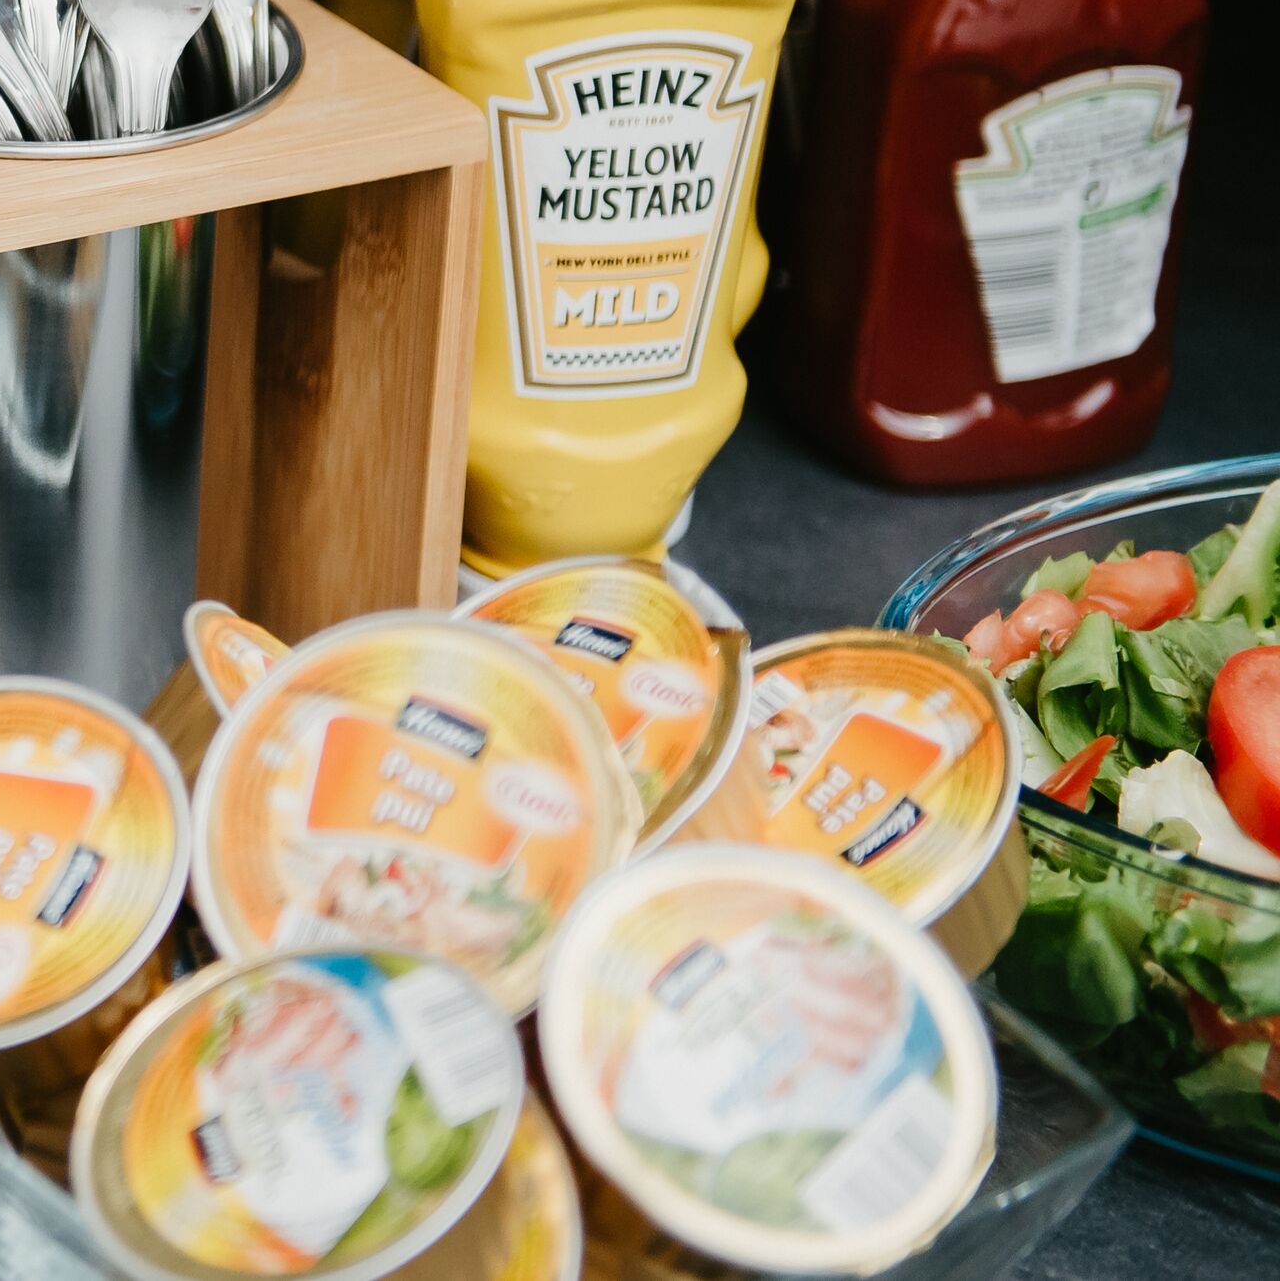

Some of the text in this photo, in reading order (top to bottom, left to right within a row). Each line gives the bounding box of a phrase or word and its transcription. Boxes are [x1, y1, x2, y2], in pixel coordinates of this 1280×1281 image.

[573, 68, 713, 117] HEINZ
[564, 139, 705, 180] YELLOW
[538, 177, 715, 221] MUSTARD
[556, 249, 690, 267] NEW YORK DELI STYLE
[553, 280, 681, 328] MILD
[819, 777, 887, 835] Pate
